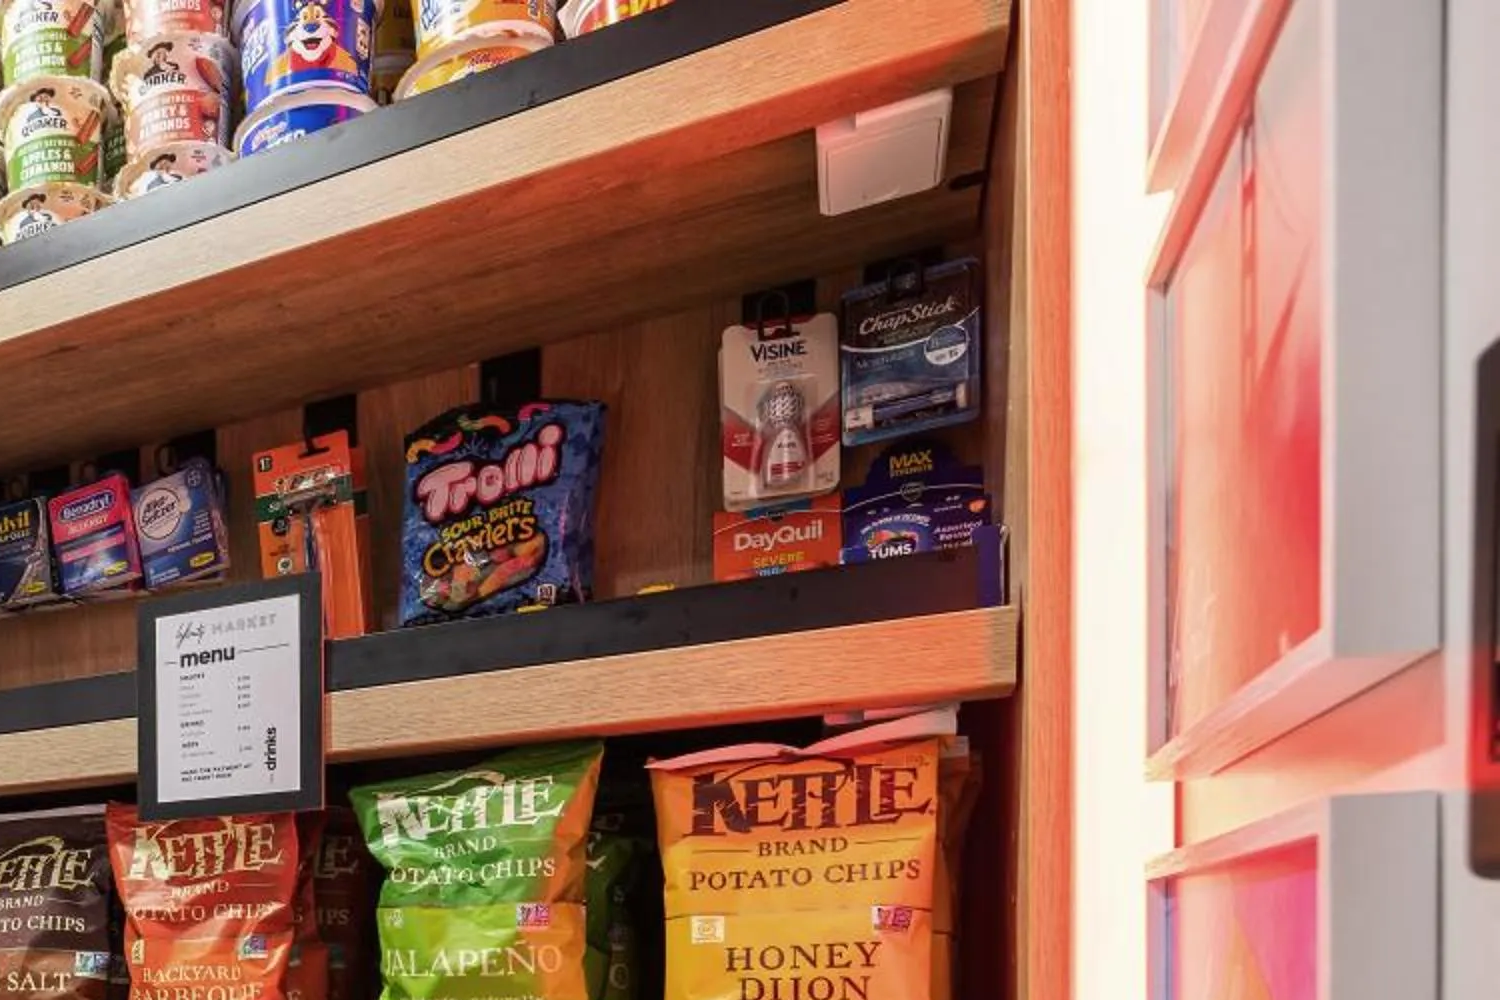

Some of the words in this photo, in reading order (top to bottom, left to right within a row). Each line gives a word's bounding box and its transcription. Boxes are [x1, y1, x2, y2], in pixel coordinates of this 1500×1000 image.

[21, 118, 68, 138] QUAKER
[21, 150, 63, 167] APPLES
[859, 295, 956, 335] ChapStick
[750, 338, 808, 363] VISINE
[416, 423, 565, 522] Trolli
[423, 513, 537, 578] Crawlers
[733, 518, 823, 552] DayQuil
[868, 543, 912, 560] TUMS
[180, 645, 235, 668] menu
[264, 726, 277, 771] drinks
[683, 755, 934, 837] KETTLE
[122, 817, 285, 881] KETTLE
[434, 836, 498, 859] BRAND
[757, 836, 849, 858] BRAND
[481, 857, 557, 882] CHIPS
[690, 867, 813, 892] POTATO
[823, 858, 922, 884] CHIPS
[27, 915, 86, 933] CHIPS
[384, 938, 563, 977] JALAPEÑO
[725, 941, 883, 972] HONEY
[7, 970, 72, 992] SALT
[143, 965, 242, 985] BACKYARD
